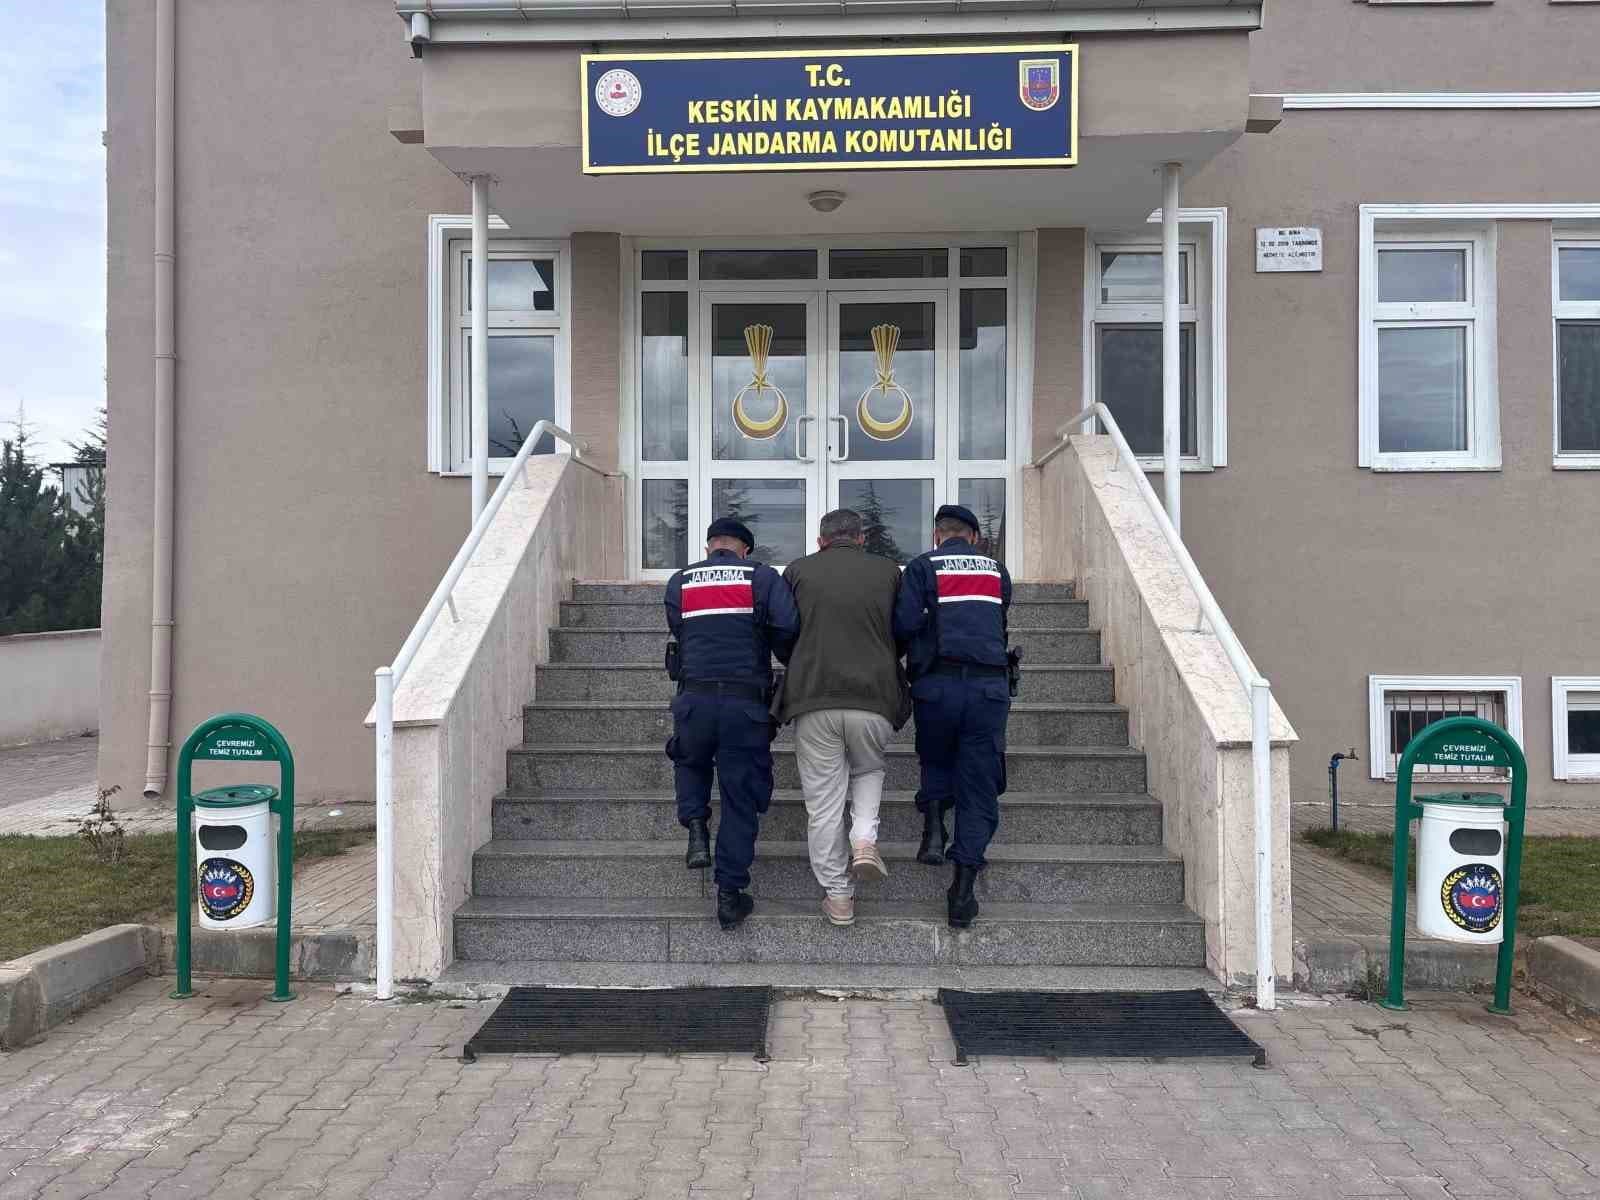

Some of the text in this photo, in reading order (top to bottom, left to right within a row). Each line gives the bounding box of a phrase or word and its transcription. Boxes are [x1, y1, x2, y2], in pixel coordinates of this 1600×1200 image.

[805, 63, 851, 87] T.C.
[688, 89, 971, 124] KESKİN KAYMAKAMLIĞI
[647, 122, 1012, 163] İLÇE JANDARMA KOMUTANLIĞI
[942, 558, 998, 571] JANDARMA
[689, 569, 745, 584] JANDARMA
[1434, 752, 1495, 762] TEMİZ TUTALIM
